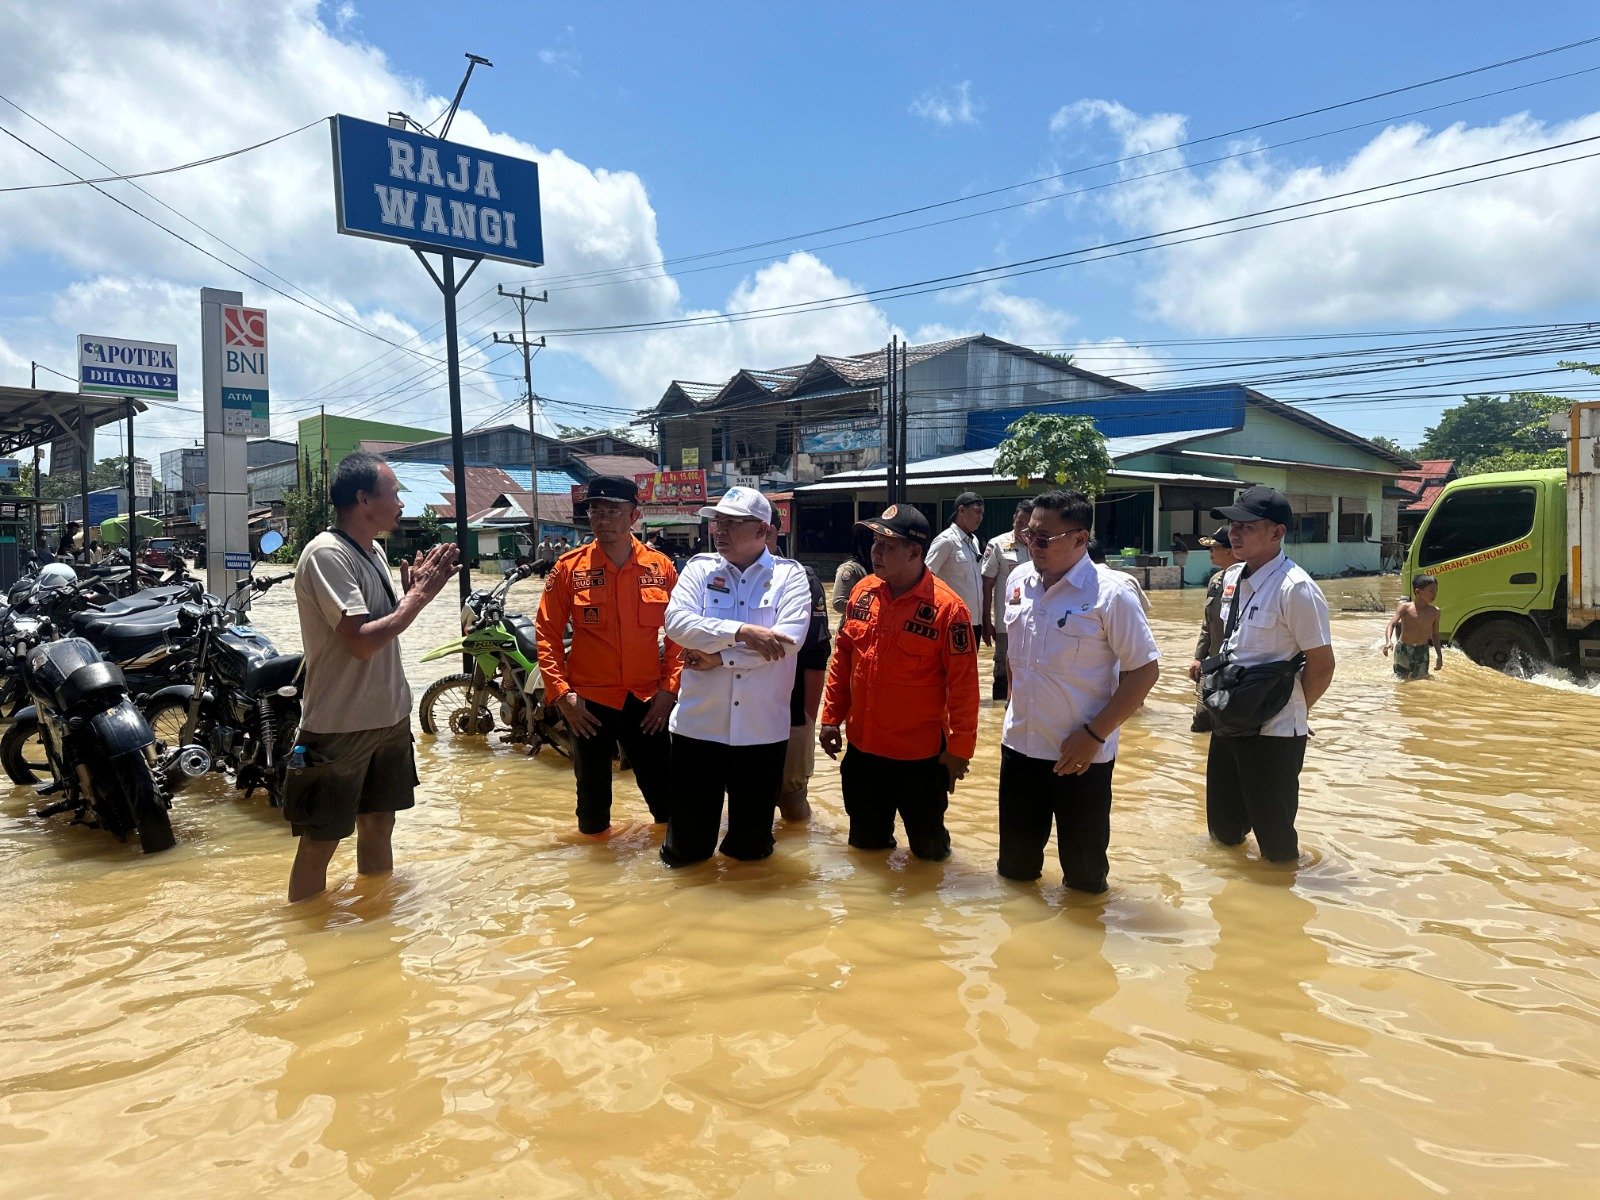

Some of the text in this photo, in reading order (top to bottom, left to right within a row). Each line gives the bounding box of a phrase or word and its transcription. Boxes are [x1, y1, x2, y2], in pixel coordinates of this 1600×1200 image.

[388, 138, 500, 200] RAJA
[374, 184, 518, 249] WANGI
[95, 343, 174, 368] APOTEK
[226, 350, 265, 374] BNI
[90, 370, 172, 387] DHARMA 2
[227, 393, 252, 401] ATM
[1426, 541, 1529, 576] DILARANG MENUMPANG
